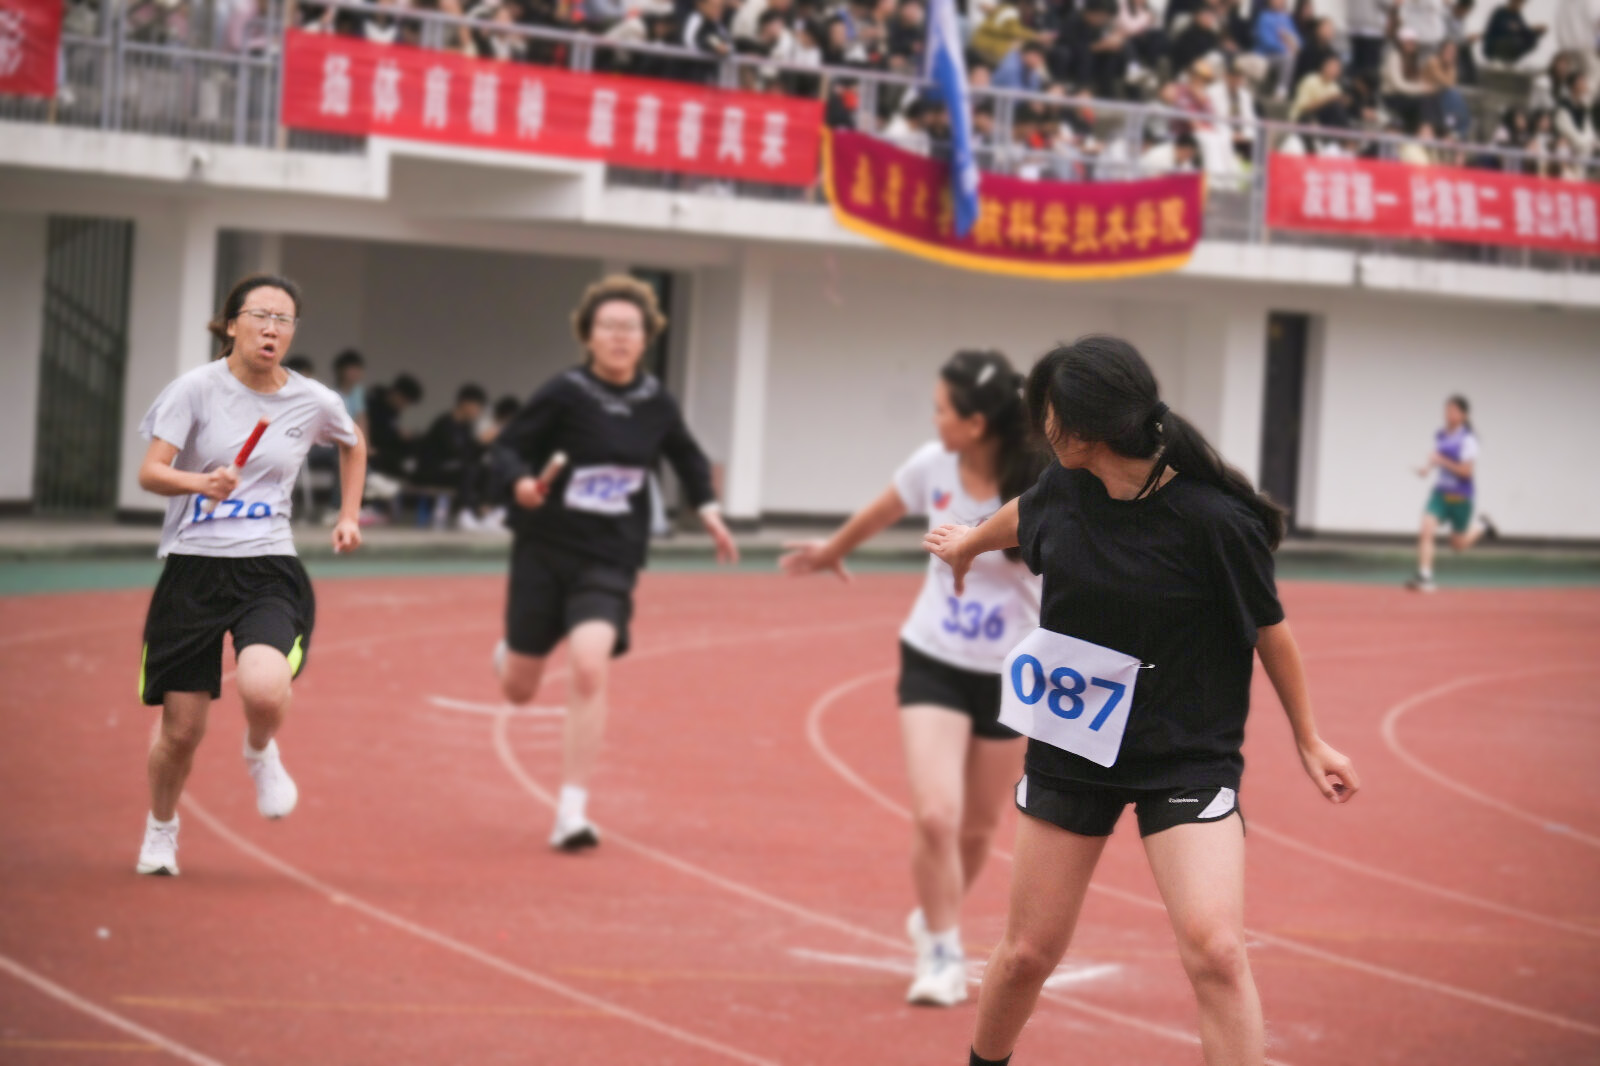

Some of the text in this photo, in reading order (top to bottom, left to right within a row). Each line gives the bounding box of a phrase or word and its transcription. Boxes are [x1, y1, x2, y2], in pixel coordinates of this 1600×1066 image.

[1303, 170, 1399, 222] 友谊第一
[1409, 174, 1503, 230] 比赛第二
[941, 595, 1006, 641] 336
[1010, 653, 1127, 732] 087
